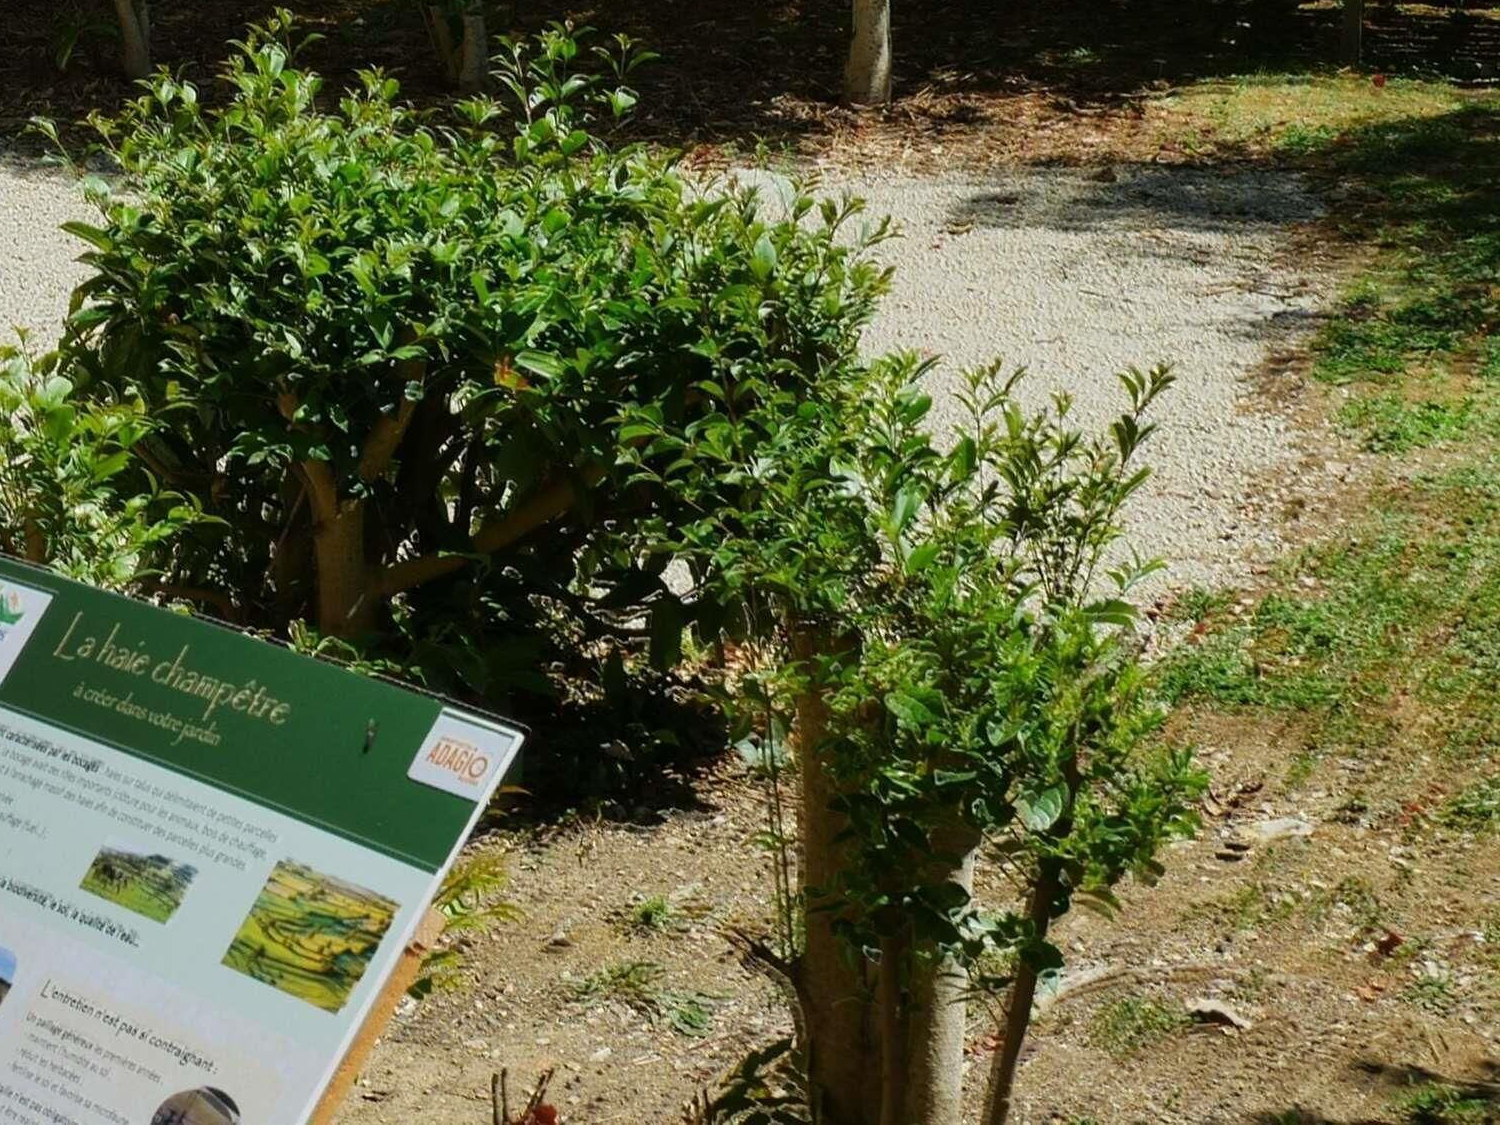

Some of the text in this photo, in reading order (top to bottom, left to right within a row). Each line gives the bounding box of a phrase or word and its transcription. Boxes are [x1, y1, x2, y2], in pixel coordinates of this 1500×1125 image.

[53, 610, 292, 725] La haie champêtre
[73, 681, 222, 746] à créer dans votre jardin
[426, 742, 488, 779] ADAGIO
[40, 979, 94, 1017] L'entretien
[93, 1008, 120, 1028] n'est
[115, 1021, 137, 1037] pas
[138, 1029, 152, 1041] si
[149, 1035, 214, 1073] contraignant
